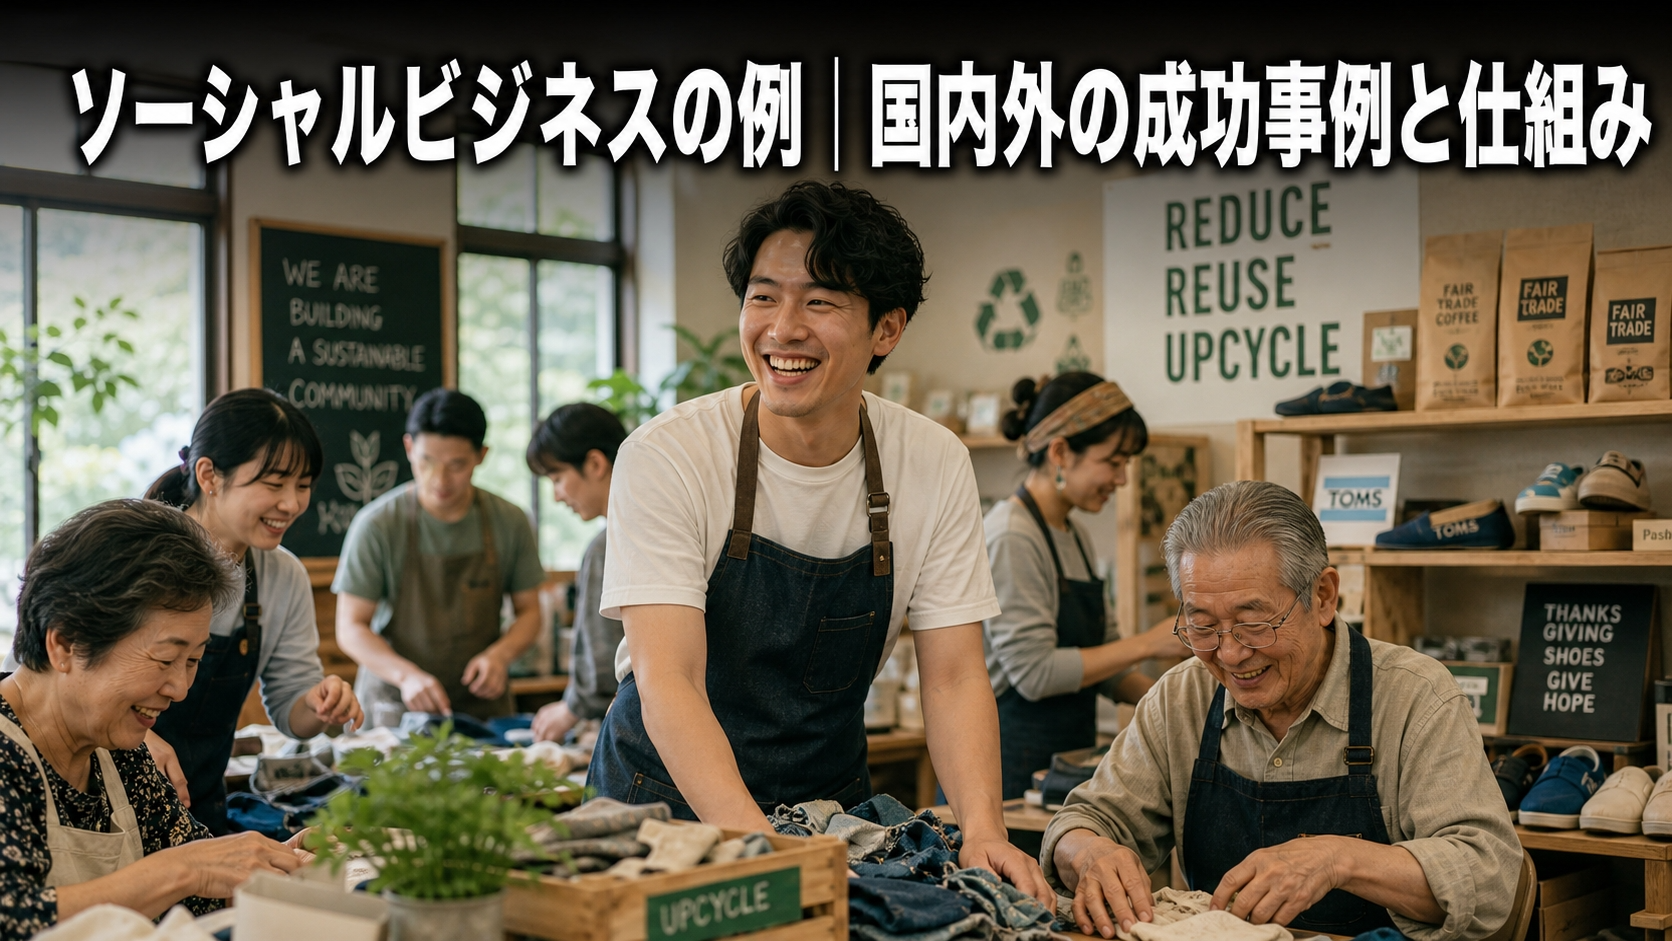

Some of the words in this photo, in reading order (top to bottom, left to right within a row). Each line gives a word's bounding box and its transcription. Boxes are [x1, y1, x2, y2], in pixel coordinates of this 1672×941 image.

[1166, 181, 1331, 250] REDUCE
[282, 257, 322, 287] WE
[333, 262, 380, 293] ARE
[1166, 255, 1295, 316] REUSE
[1443, 283, 1474, 296] FAIR
[1525, 281, 1558, 298] FAIR
[1437, 297, 1479, 310] TRADE
[1521, 298, 1564, 315] TRADE
[1612, 304, 1646, 320] FAIR
[290, 298, 383, 331] BUILDING
[1436, 311, 1479, 326] COFFEE
[1610, 320, 1652, 337] TRADE
[287, 336, 306, 364] A
[1166, 322, 1340, 383] UPCYCLE
[288, 378, 418, 413] COMMUNITY
[1328, 489, 1382, 509] TOMS
[1434, 519, 1480, 540] TOMS
[1544, 604, 1621, 623] THANKS
[1543, 623, 1614, 643] GIVING
[1543, 647, 1605, 667] SHOES
[1547, 671, 1594, 691] GIVE
[1543, 692, 1596, 714] HOPE
[660, 880, 771, 936] UPCYCLE
